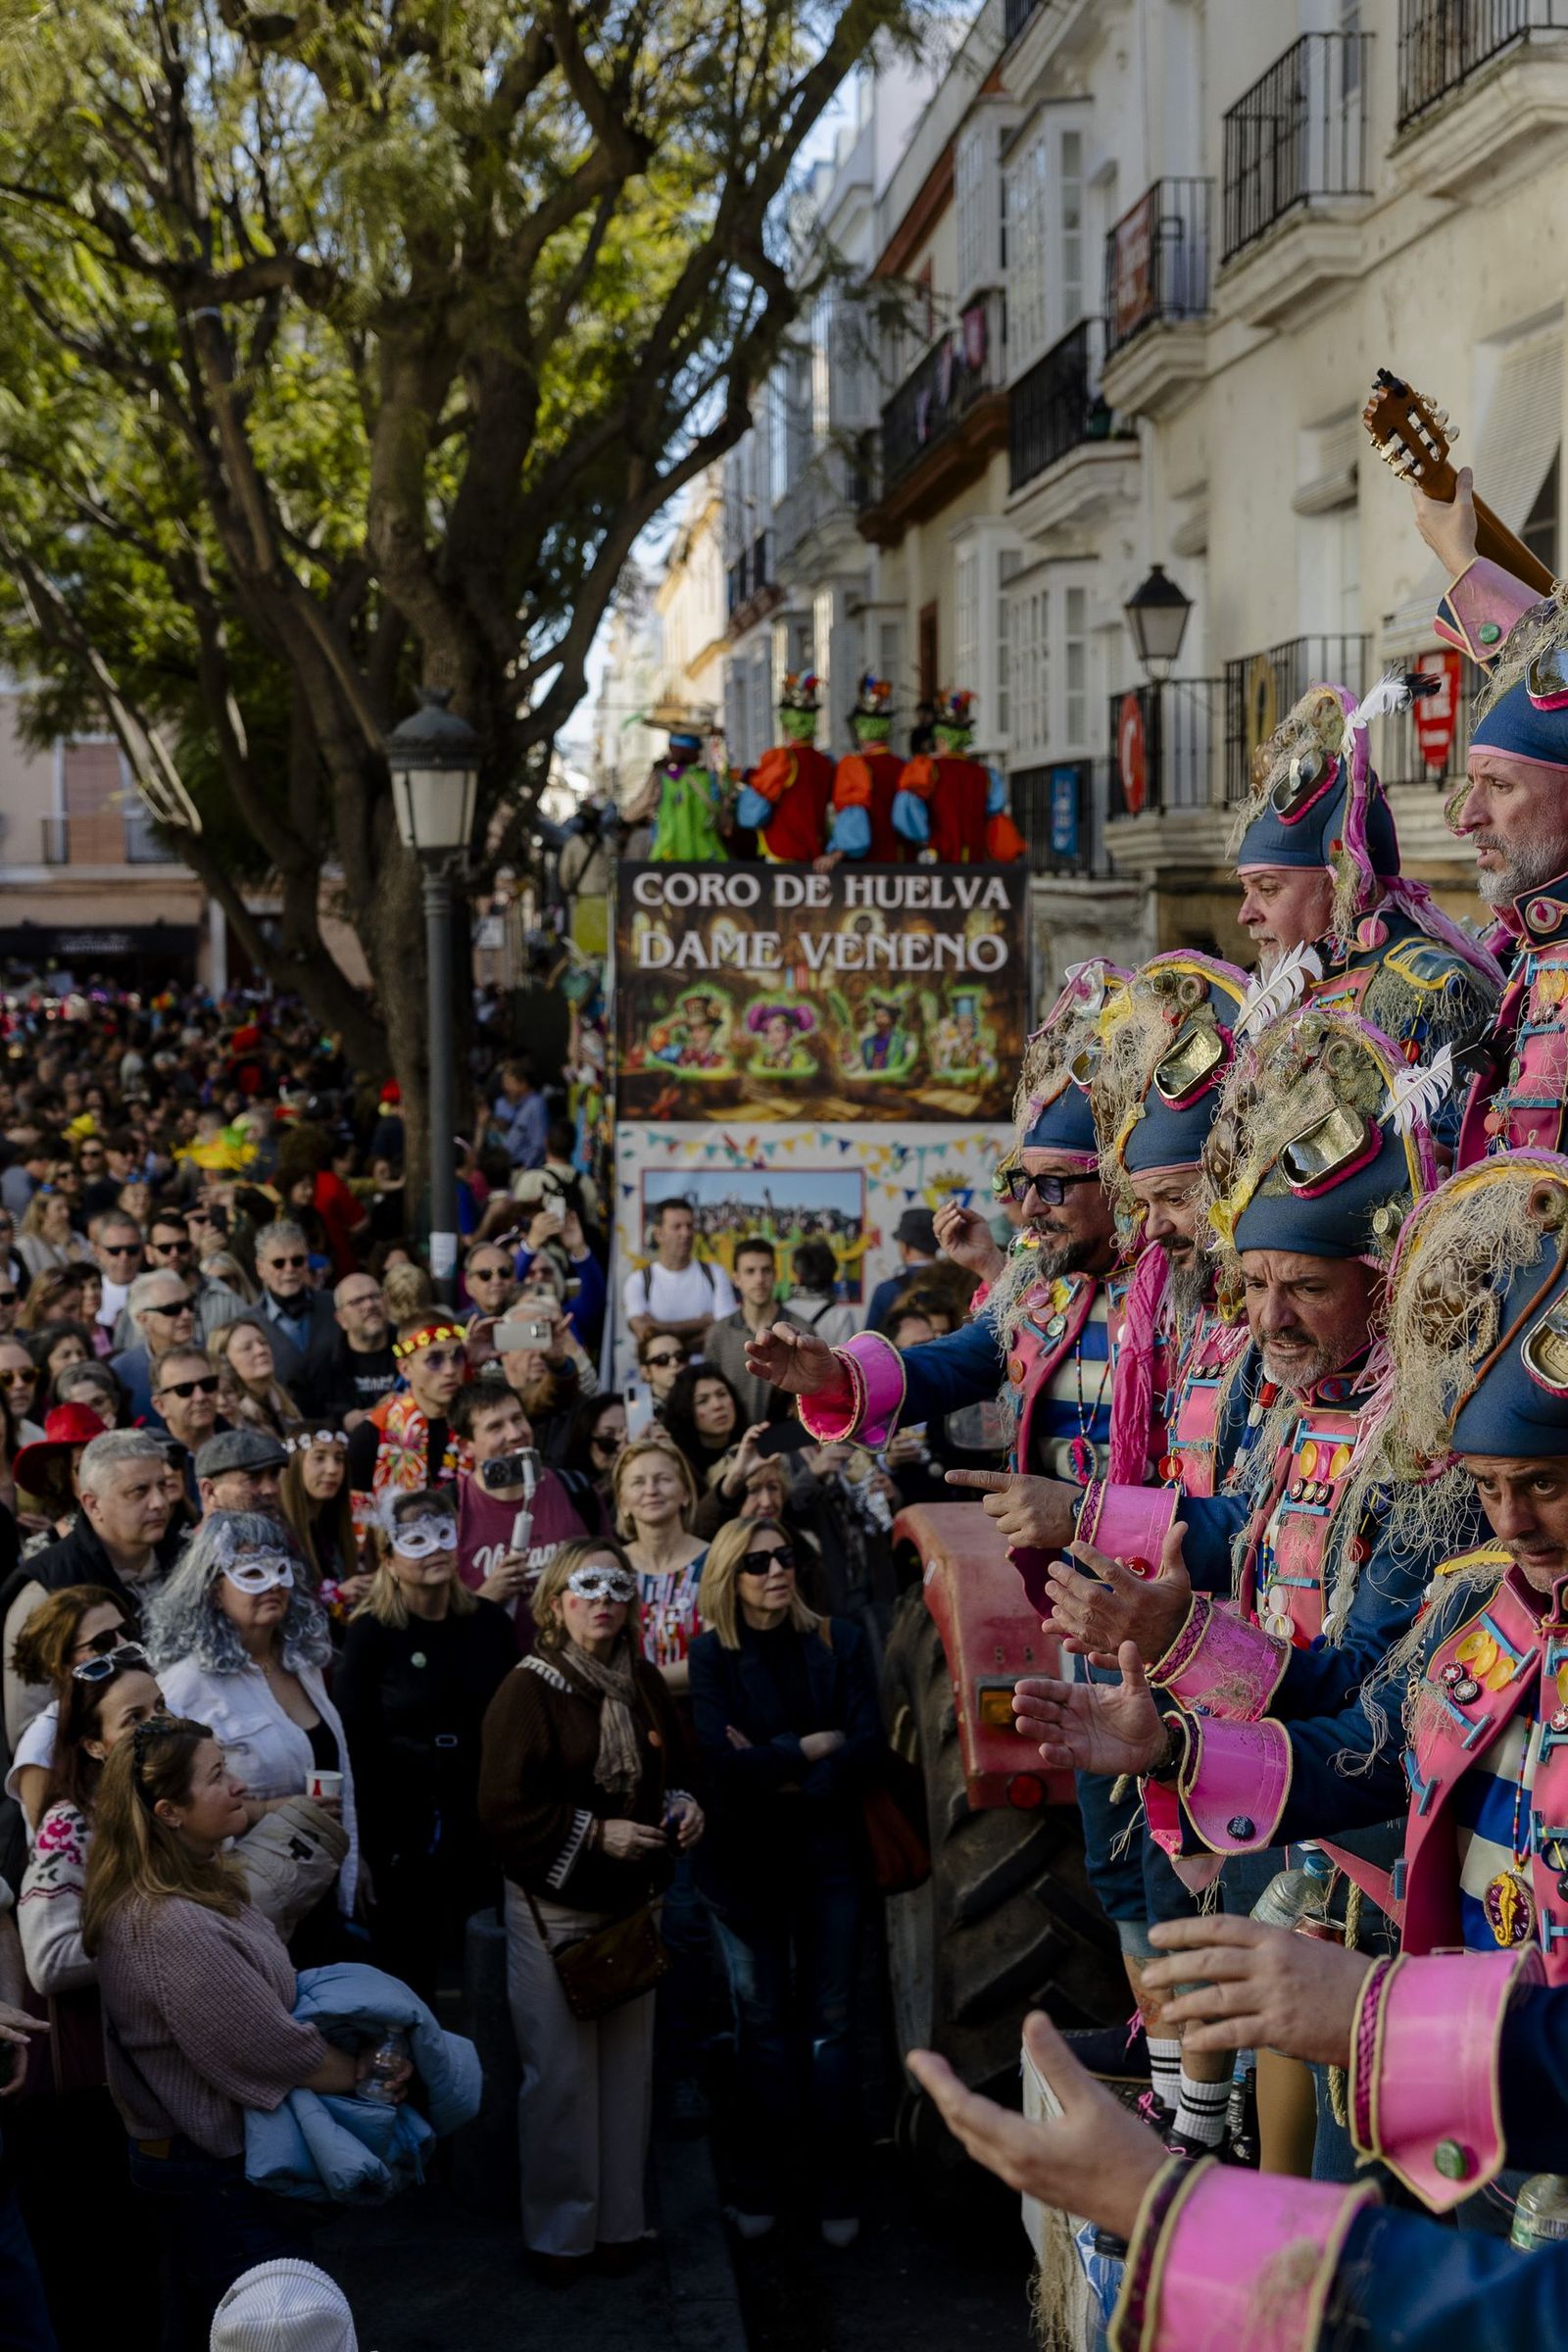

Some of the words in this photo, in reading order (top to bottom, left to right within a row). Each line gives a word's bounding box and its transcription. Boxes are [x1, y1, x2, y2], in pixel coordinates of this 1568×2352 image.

[632, 872, 761, 907] CORO
[772, 873, 834, 908] DE
[843, 874, 1011, 909] HUELVA
[638, 930, 784, 970] DAME
[799, 932, 1009, 973] VENENO
